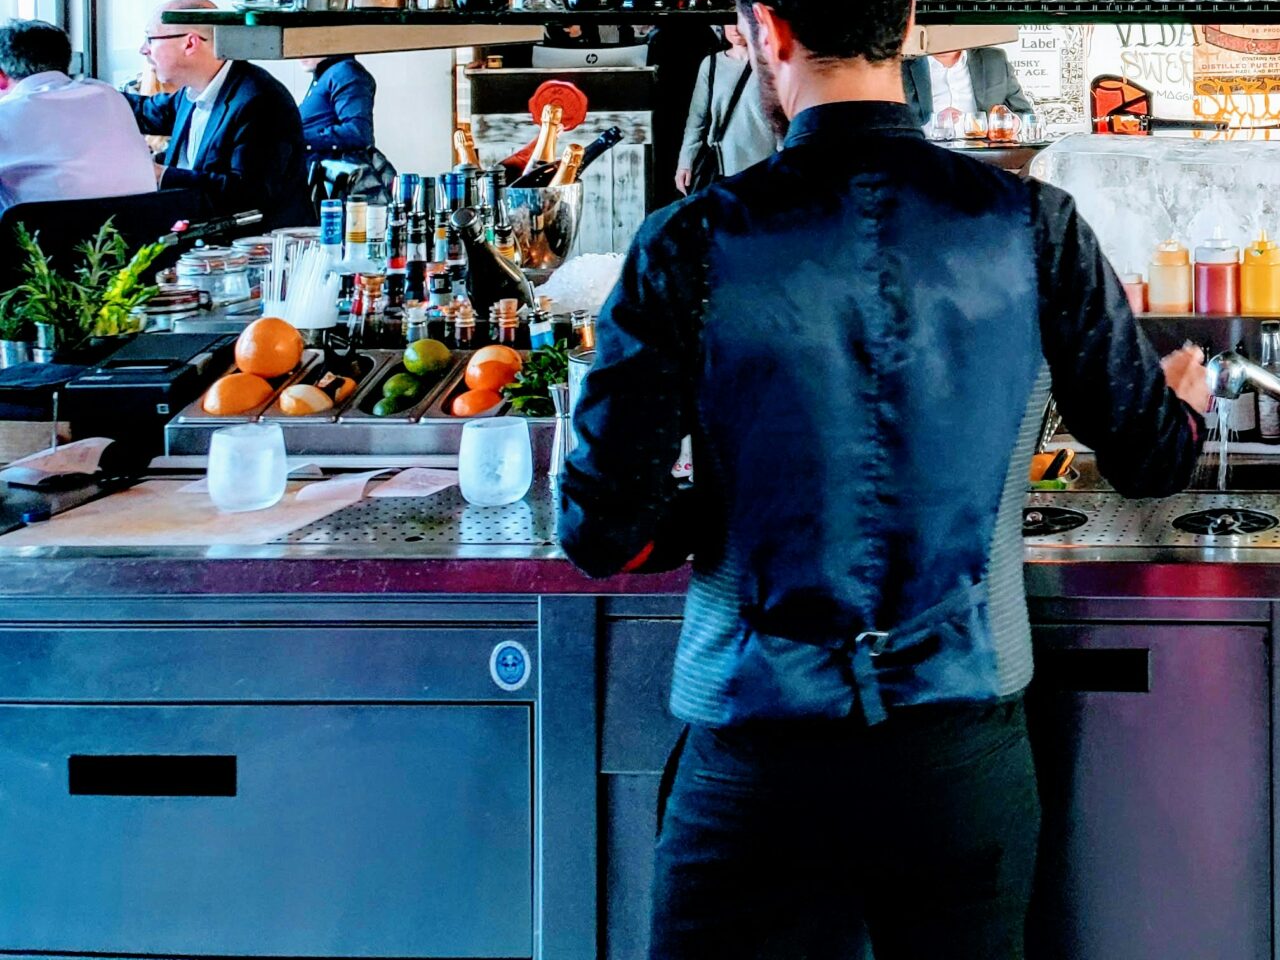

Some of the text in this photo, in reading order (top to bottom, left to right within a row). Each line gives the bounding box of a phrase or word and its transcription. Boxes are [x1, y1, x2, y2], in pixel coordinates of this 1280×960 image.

[1021, 37, 1056, 49] Label
[1011, 59, 1041, 68] HISKY
[1201, 62, 1248, 70] DISTILLED
